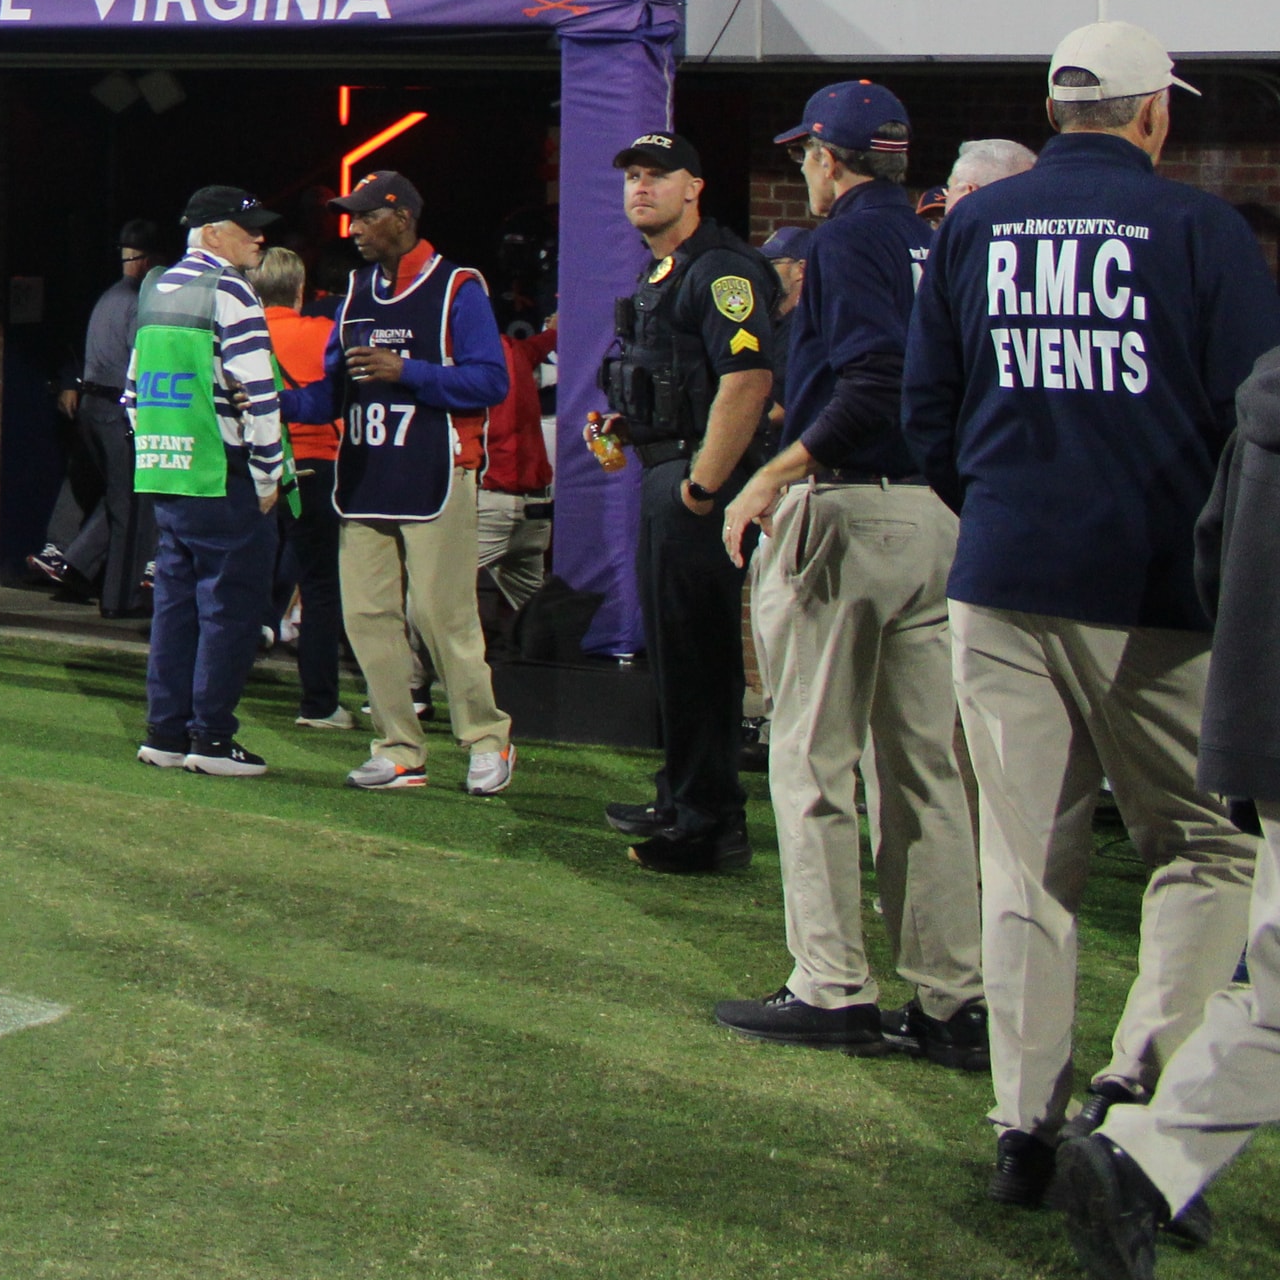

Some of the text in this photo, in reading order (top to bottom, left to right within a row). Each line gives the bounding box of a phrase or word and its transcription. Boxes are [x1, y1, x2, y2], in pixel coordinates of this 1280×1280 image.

[991, 218, 1150, 240] www.RMCEVENTS.com
[716, 279, 748, 292] POLICE
[986, 237, 1147, 320] R.M.C.
[371, 328, 414, 339] VIRGINIA
[990, 327, 1149, 395] EVENTS
[137, 371, 198, 400] ACC
[348, 402, 416, 448] 087
[135, 434, 195, 452] NSTANT
